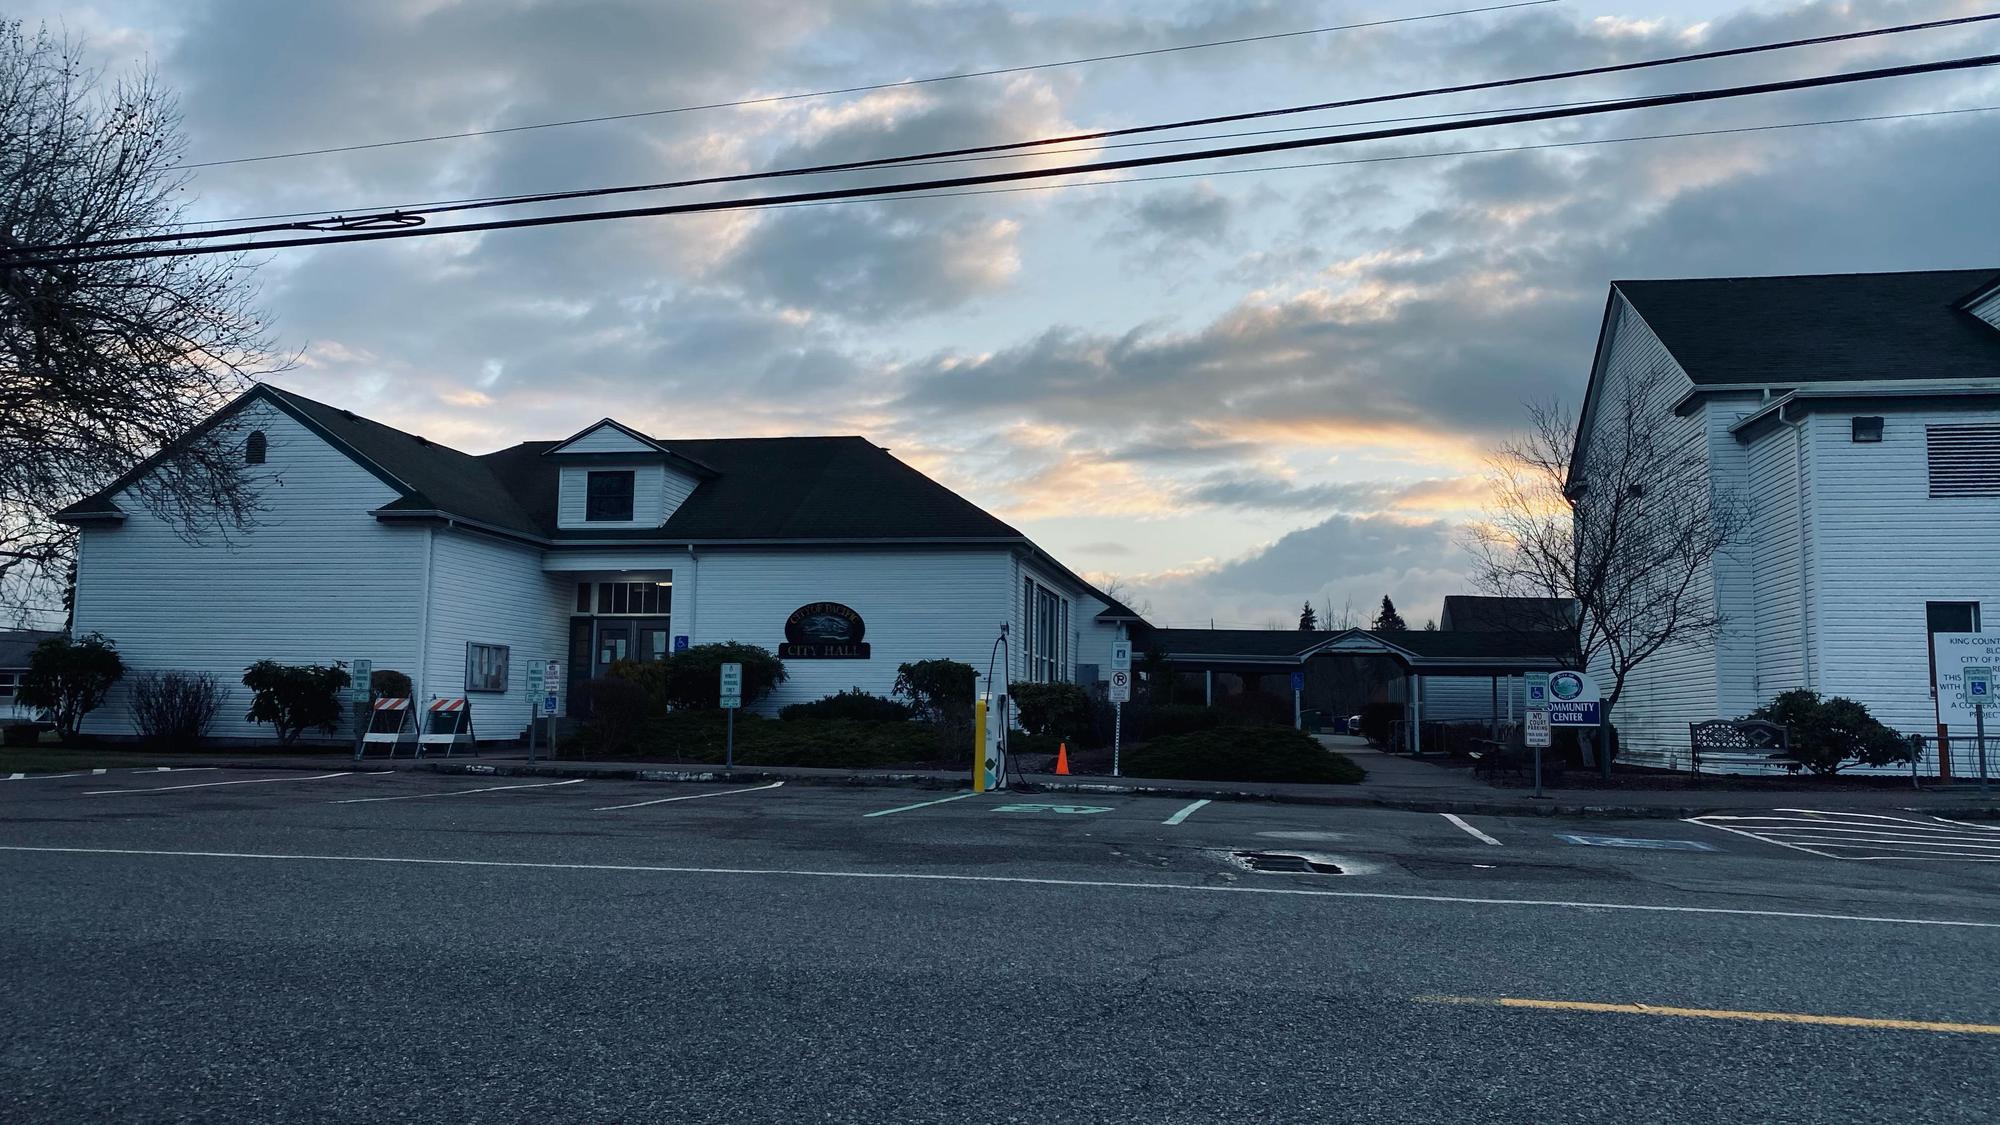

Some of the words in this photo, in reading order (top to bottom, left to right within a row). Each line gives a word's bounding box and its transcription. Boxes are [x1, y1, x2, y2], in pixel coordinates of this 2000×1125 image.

[1950, 637, 1970, 645] KING
[788, 645, 817, 656] CITY
[824, 645, 861, 656] HALL
[1542, 703, 1595, 712] OMMUNITY
[1553, 713, 1583, 722] CENTER
